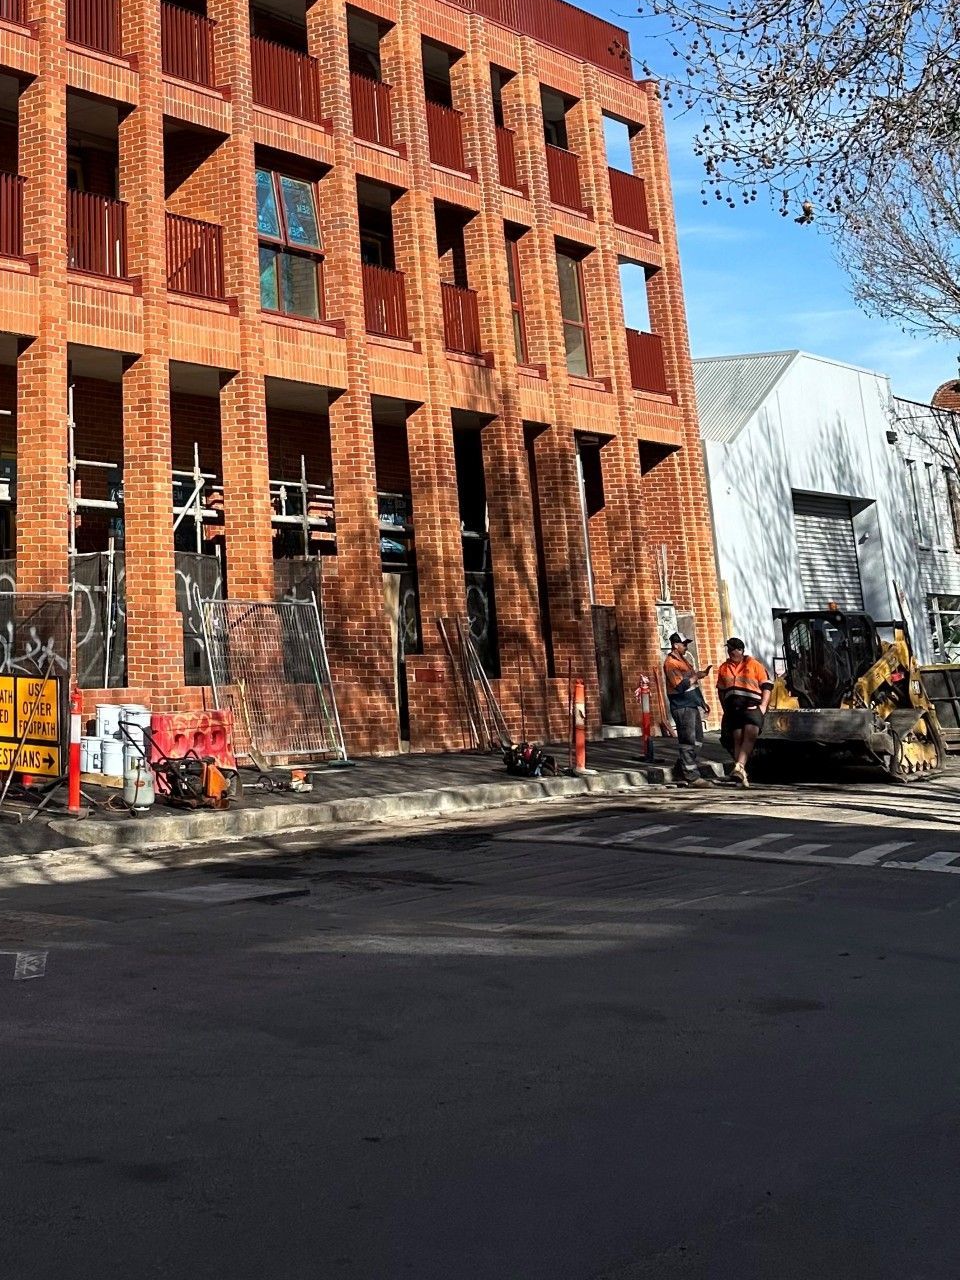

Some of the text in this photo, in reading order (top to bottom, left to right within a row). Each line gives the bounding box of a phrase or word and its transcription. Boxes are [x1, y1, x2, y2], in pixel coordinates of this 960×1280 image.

[28, 682, 46, 698] USE
[22, 701, 52, 717] OTHER
[19, 719, 56, 737] FOOTPATH
